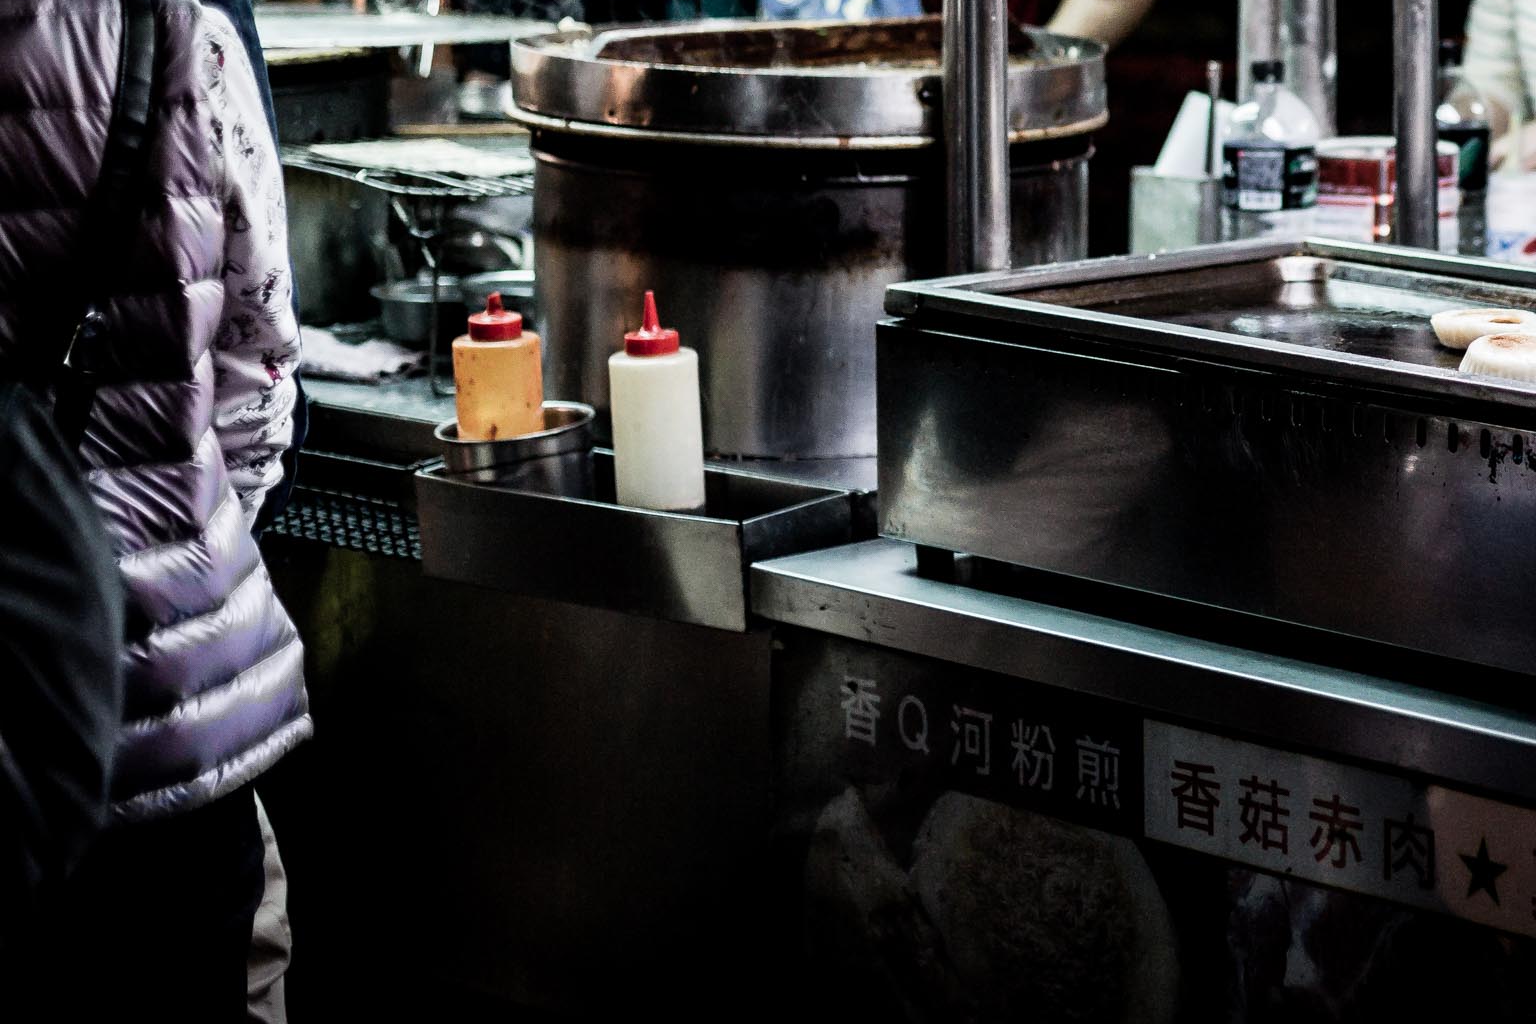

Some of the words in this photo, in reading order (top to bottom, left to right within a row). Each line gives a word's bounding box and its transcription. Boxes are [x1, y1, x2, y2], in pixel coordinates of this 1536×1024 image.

[840, 675, 1122, 811] 香Q河粉煎
[1170, 759, 1437, 890] 香菇赤肉
